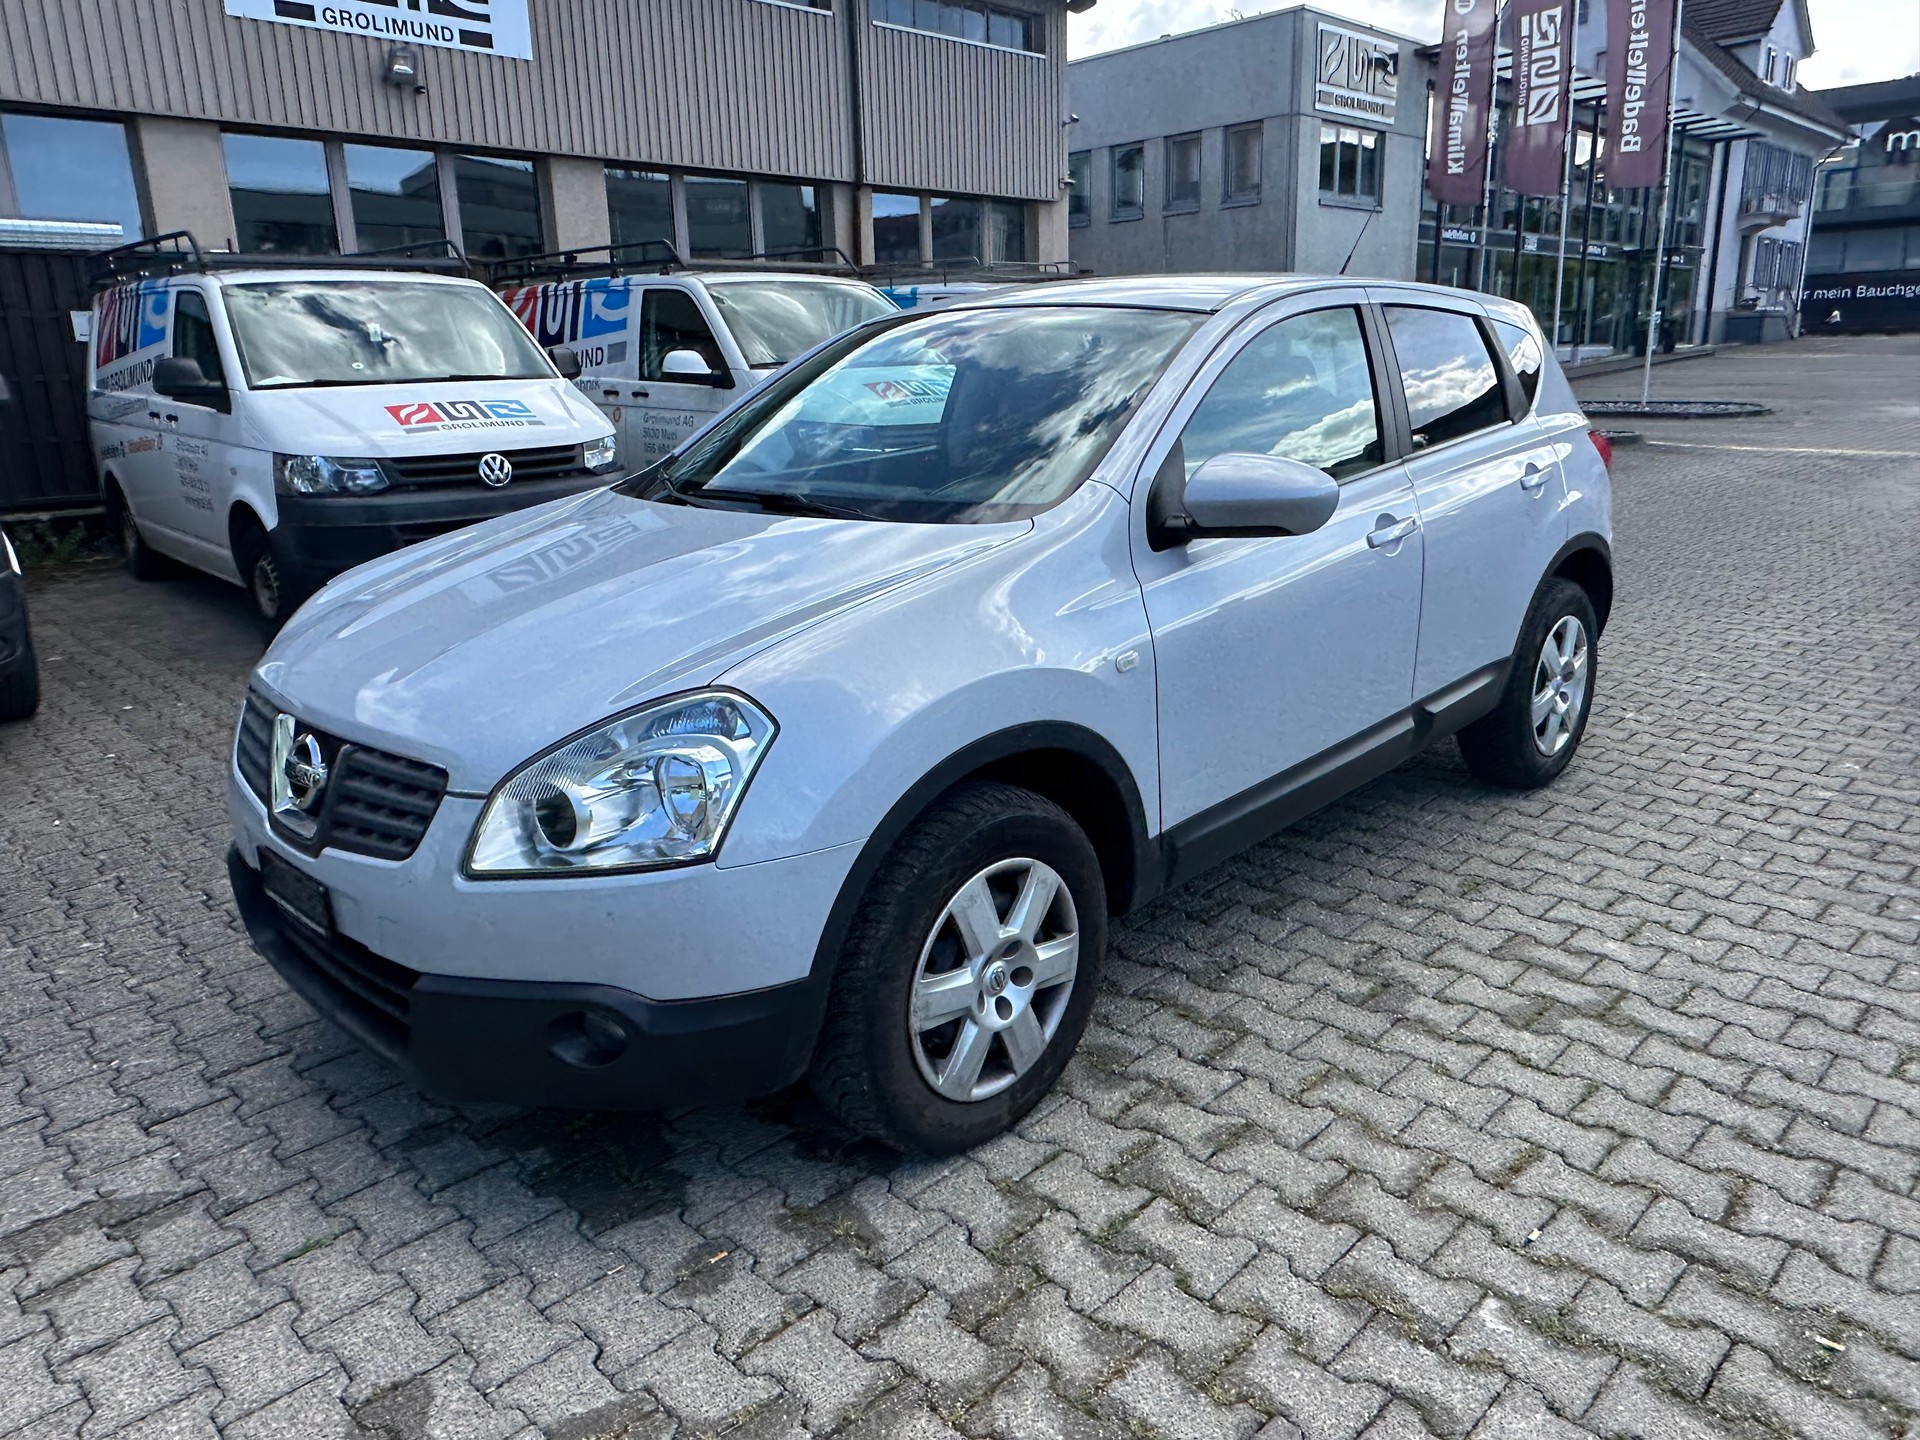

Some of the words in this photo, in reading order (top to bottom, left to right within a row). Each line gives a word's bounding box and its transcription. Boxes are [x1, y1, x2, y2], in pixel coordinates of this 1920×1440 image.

[322, 7, 454, 42] GROLIMUND
[1334, 94, 1385, 115] GROLIMUND
[1813, 287, 1851, 300] mein
[441, 420, 525, 431] GROLIMUND
[683, 415, 694, 427] AG
